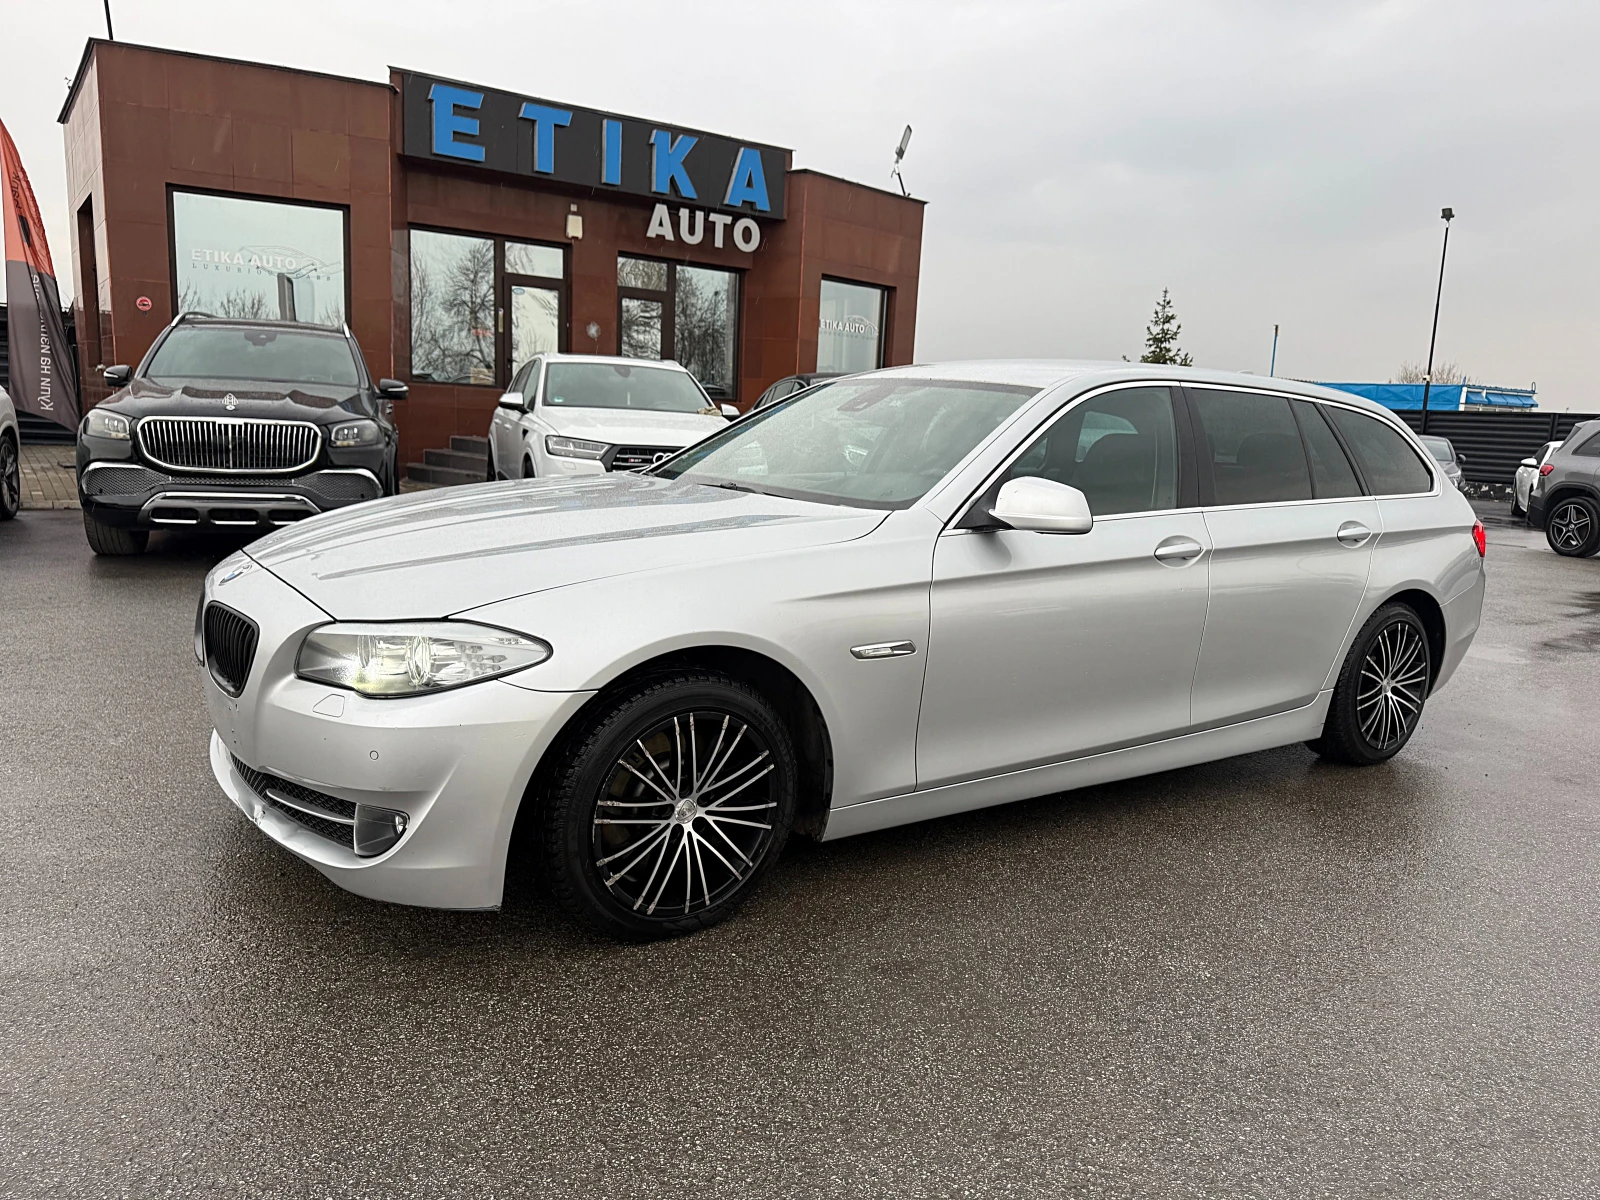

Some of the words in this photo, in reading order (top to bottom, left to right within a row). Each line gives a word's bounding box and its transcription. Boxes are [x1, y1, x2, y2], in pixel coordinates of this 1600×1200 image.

[428, 83, 771, 212] ETIKA
[646, 203, 761, 253] AUTO
[191, 249, 245, 266] ETIKA
[250, 254, 297, 270] AUTO
[192, 262, 274, 276] LUXURIOU
[820, 319, 843, 331] ETIKA
[844, 322, 865, 334] AUTO
